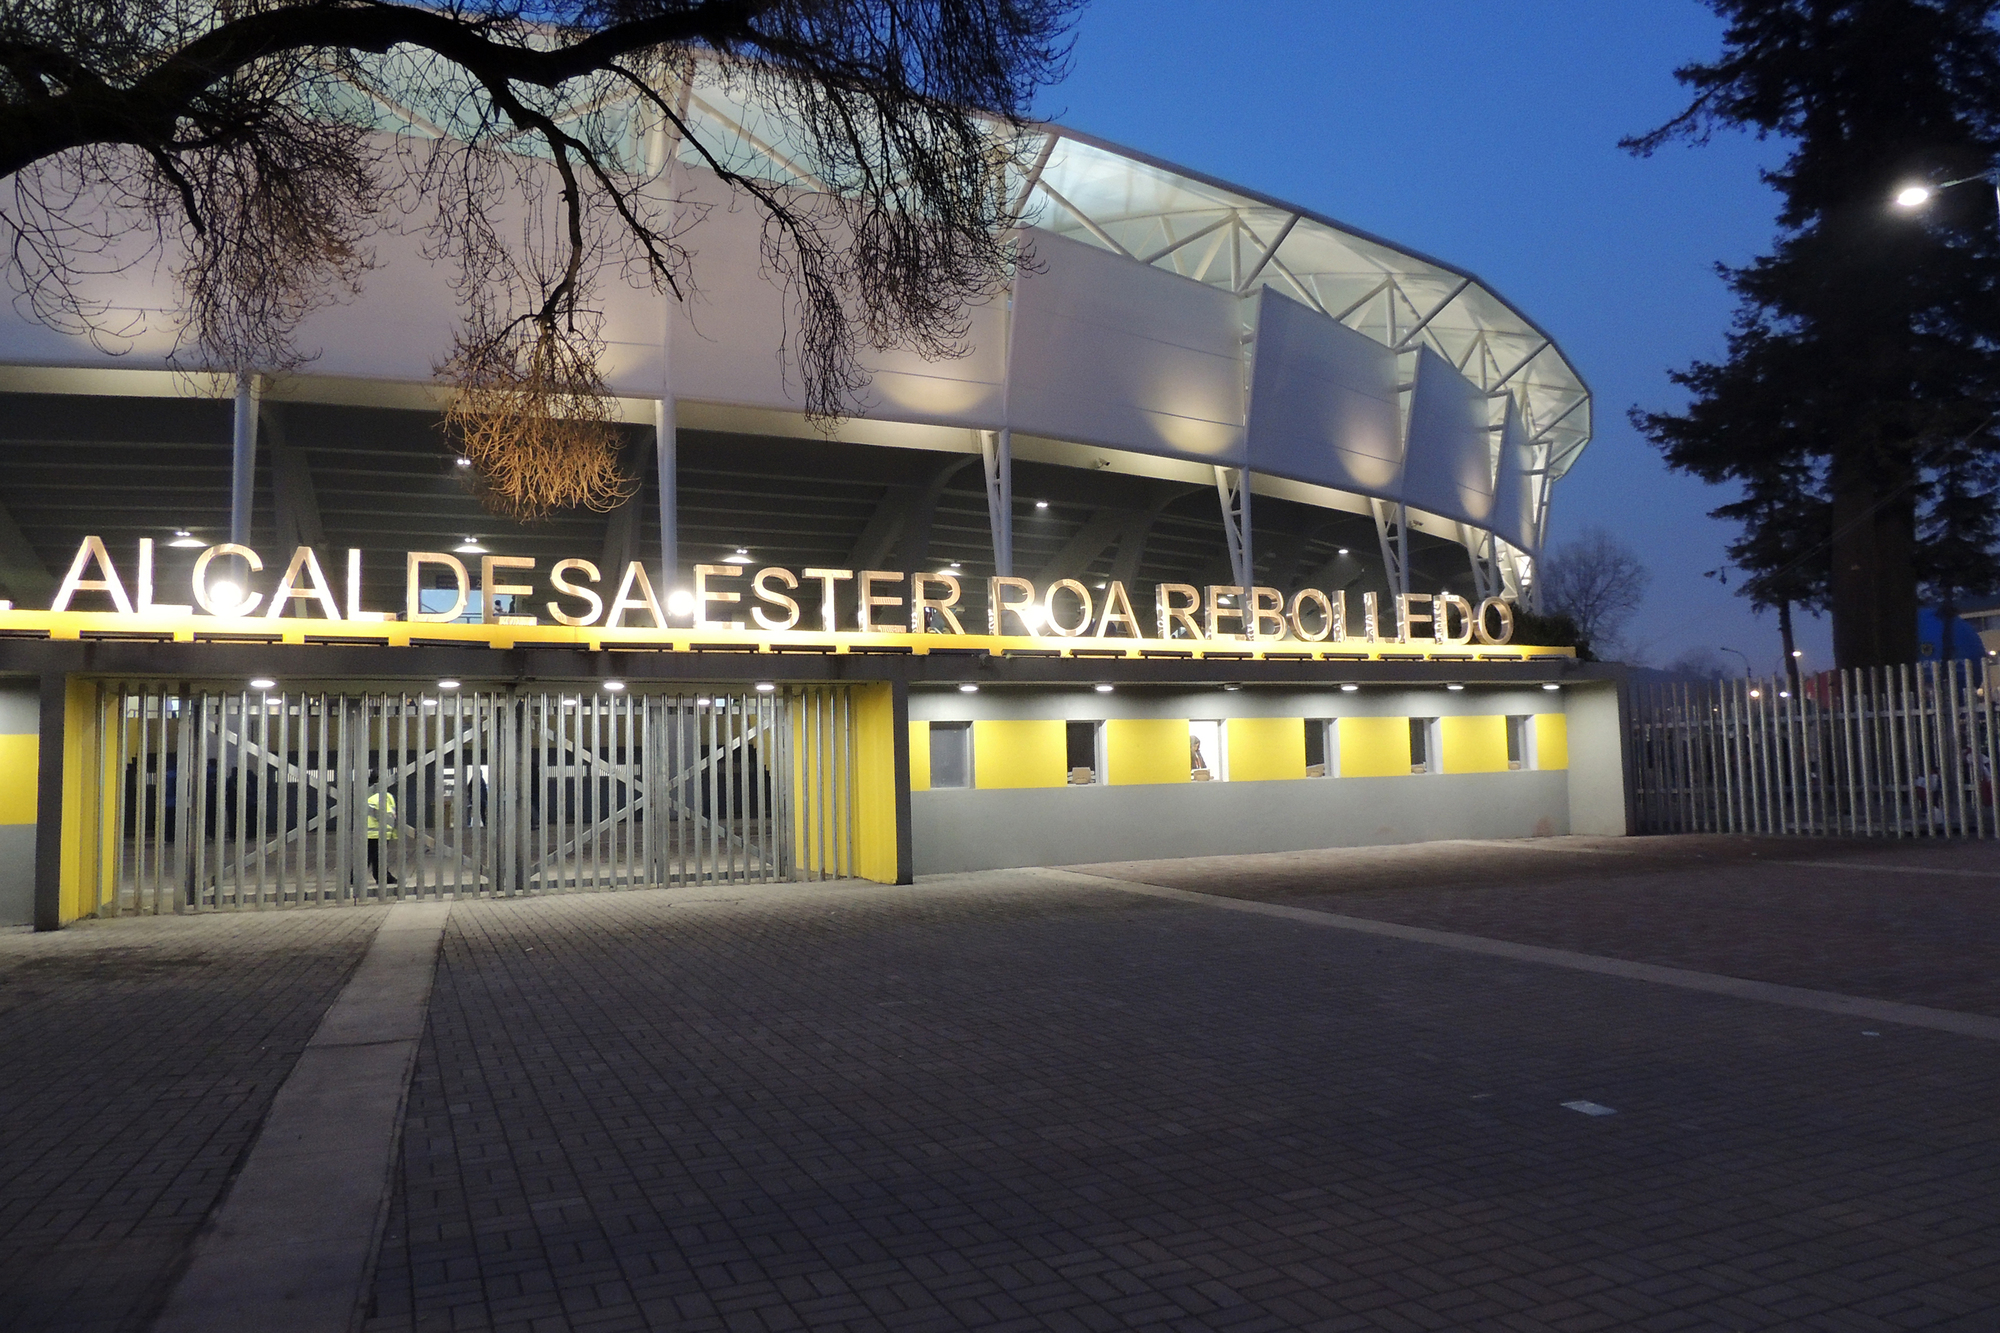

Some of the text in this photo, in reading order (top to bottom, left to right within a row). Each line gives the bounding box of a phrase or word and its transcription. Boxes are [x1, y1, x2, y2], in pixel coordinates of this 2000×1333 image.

[51, 535, 1514, 645] ALCALDESA ESTER ROA REBOLLEDO
